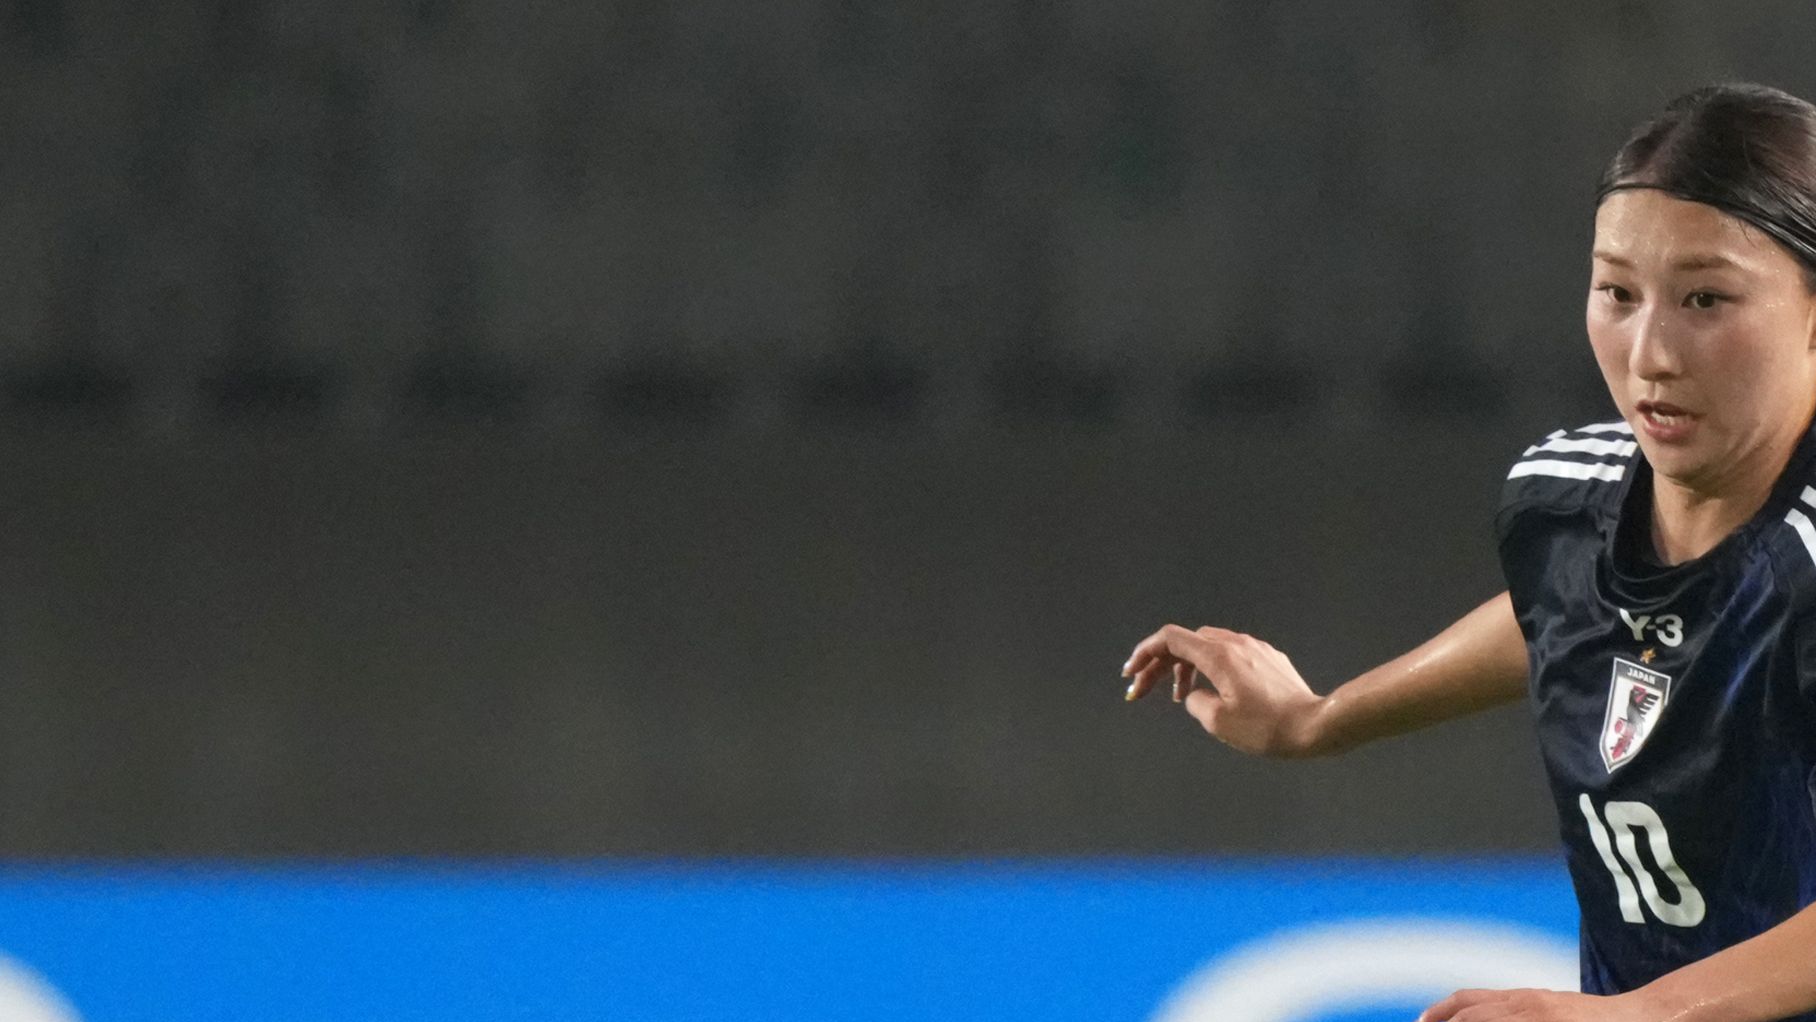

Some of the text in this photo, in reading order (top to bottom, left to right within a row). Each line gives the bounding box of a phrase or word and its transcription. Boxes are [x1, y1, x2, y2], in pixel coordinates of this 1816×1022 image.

[1618, 607, 1684, 648] Y-3
[1626, 666, 1657, 686] JAPAN
[1578, 792, 1706, 928] 10
